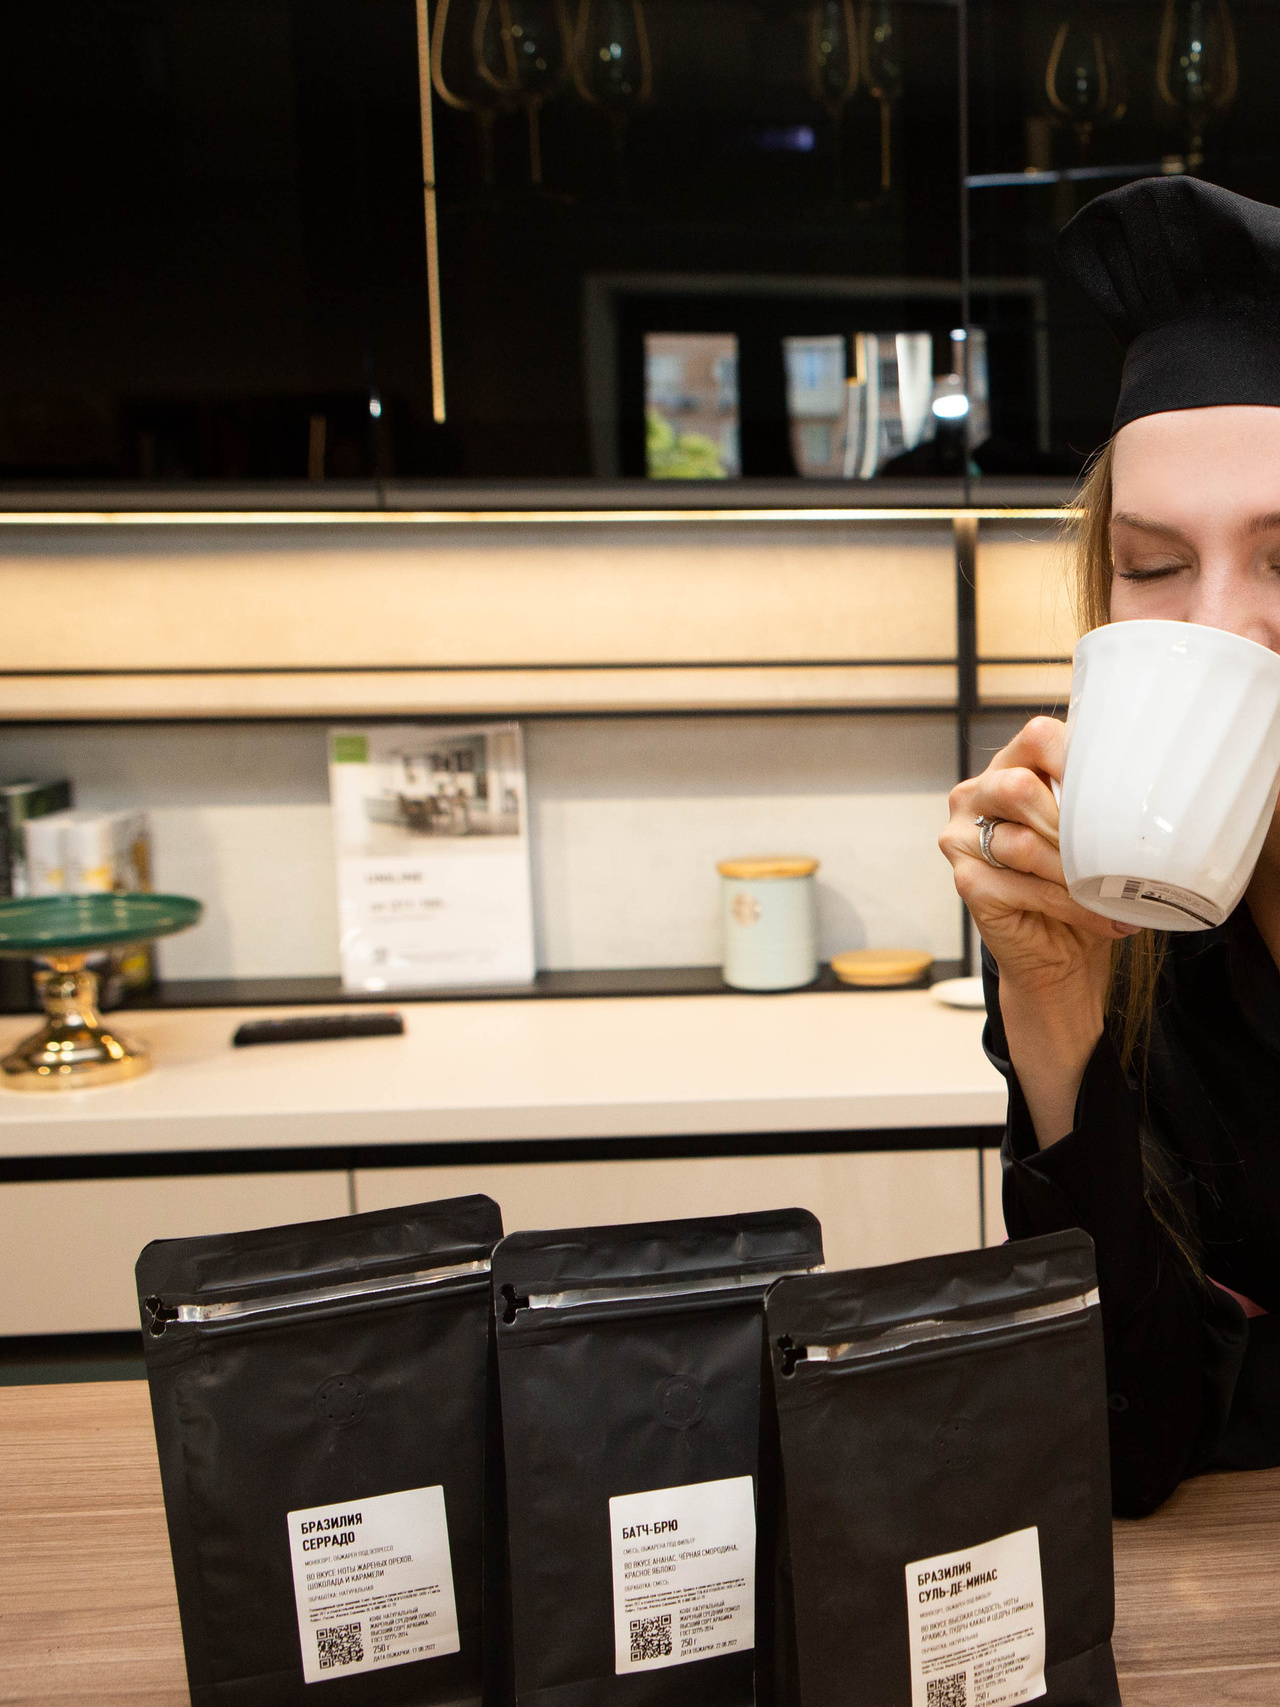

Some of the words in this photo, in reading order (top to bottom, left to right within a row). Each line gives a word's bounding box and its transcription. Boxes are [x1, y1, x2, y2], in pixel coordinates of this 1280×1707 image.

[301, 1513, 363, 1534] БРАЗИЛИЯ
[622, 1519, 678, 1539] БАТЧ-БРЮ
[302, 1531, 355, 1551] СЕРРАДО
[623, 1561, 633, 1571] ВО
[632, 1558, 651, 1569] ВКУСЕ
[652, 1554, 677, 1565] АНАНАС,
[678, 1550, 701, 1560] ЧЁРНАЯ
[701, 1544, 738, 1557] СМОРОДИНА,
[306, 1572, 316, 1582] ВО
[316, 1569, 335, 1580] ВКУСЕ
[337, 1565, 356, 1575] НОТЫ
[356, 1559, 388, 1572] ЖАРЕНЫХ
[307, 1577, 344, 1591] ШОКОЛАДА
[351, 1570, 385, 1582] КАРАМЕЛИ
[624, 1568, 651, 1580] КРАСНОЕ
[651, 1564, 677, 1575] ЯБЛОКО
[917, 1562, 971, 1586] БРАЗИЛИЯ
[338, 1584, 374, 1596] НАТУРАЛЬНАЯ
[918, 1569, 997, 1603] СУЛЬ-ДЕ-МИНАС
[929, 1619, 947, 1631] ВКУСЕ
[948, 1611, 974, 1626] ВЫСОКАЯ
[973, 1602, 1002, 1617] СЛАДОСТЬ,
[1003, 1596, 1020, 1607] НОТЫ
[948, 1622, 969, 1635] ПУДРЫ
[969, 1616, 986, 1627] КАКАО
[991, 1609, 1011, 1621] ЦЕДРЫ
[1011, 1601, 1034, 1614] ЛИМОНА
[372, 1643, 386, 1654] 250
[680, 1637, 693, 1648] 250
[373, 1654, 386, 1663] ДАТА
[975, 1691, 987, 1703] 250
